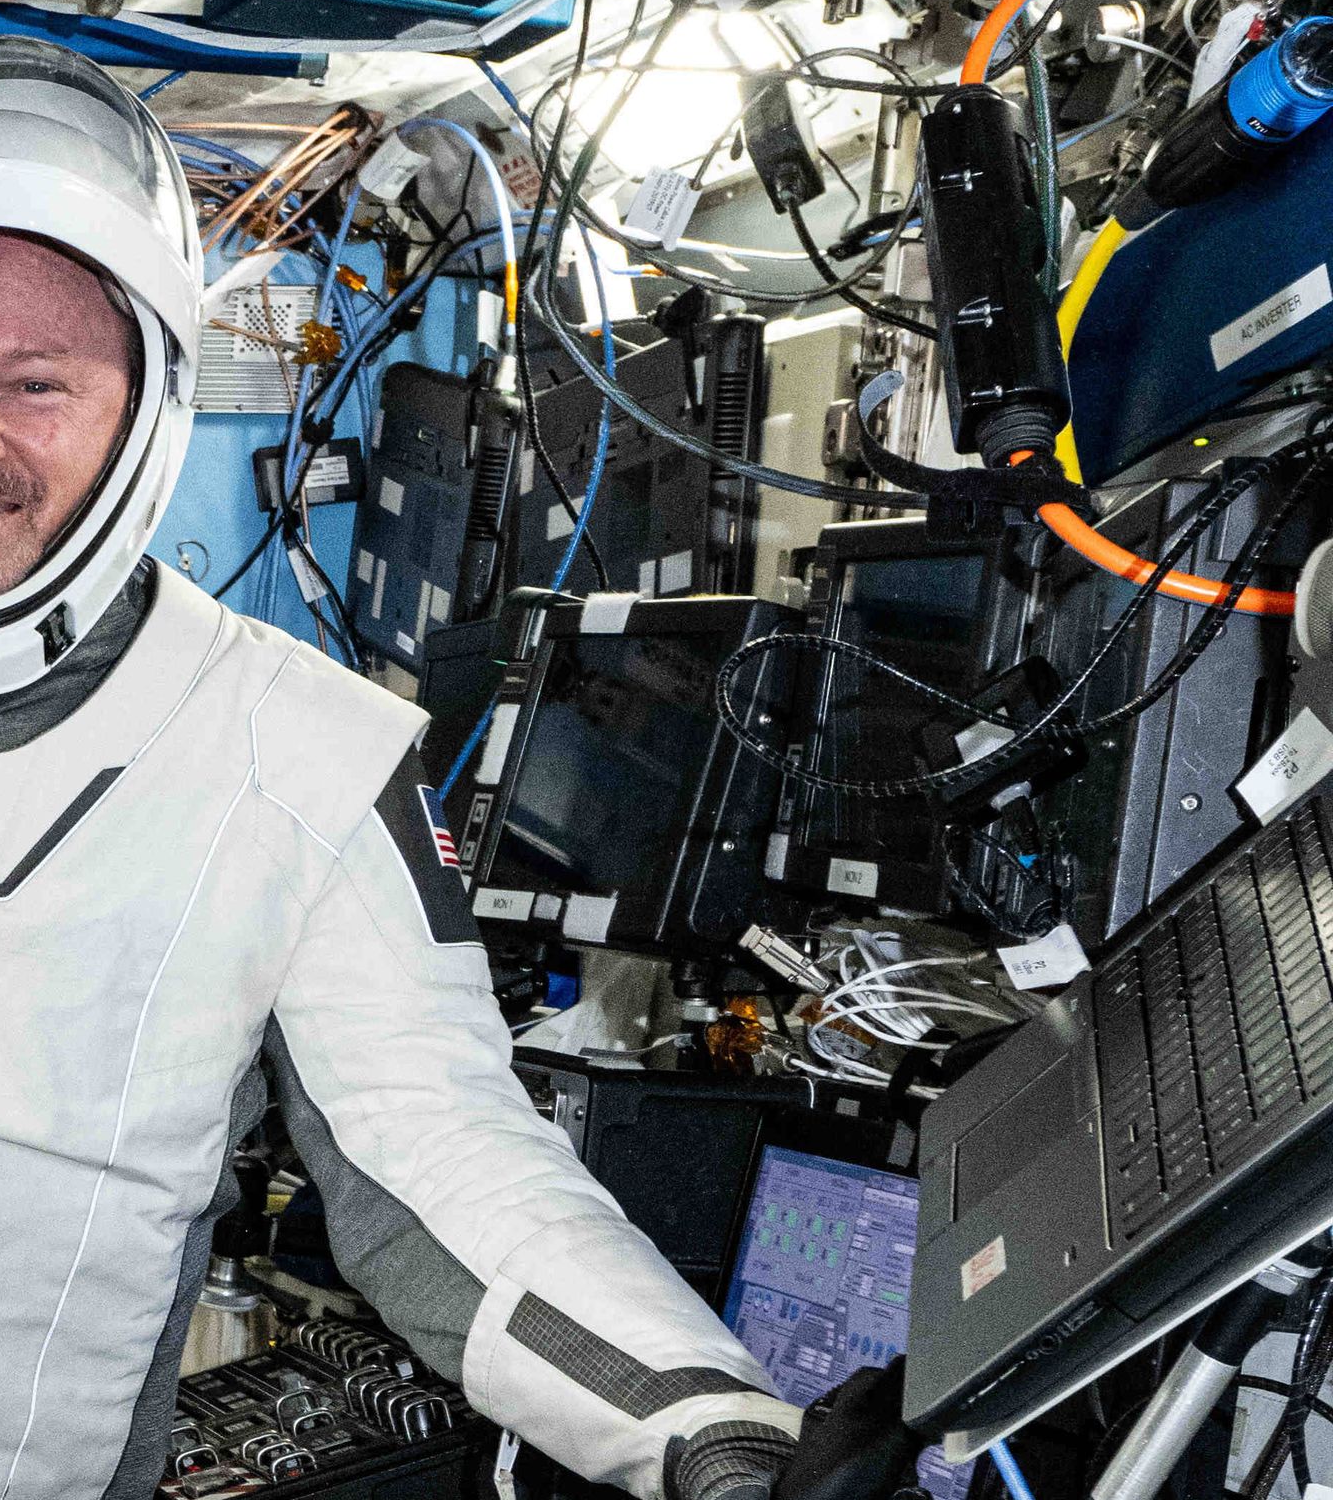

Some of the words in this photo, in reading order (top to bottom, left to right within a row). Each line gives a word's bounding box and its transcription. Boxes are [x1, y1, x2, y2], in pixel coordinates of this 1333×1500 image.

[1239, 325, 1258, 344] AC
[1260, 294, 1303, 336] INVERTER
[1282, 762, 1300, 780] P2
